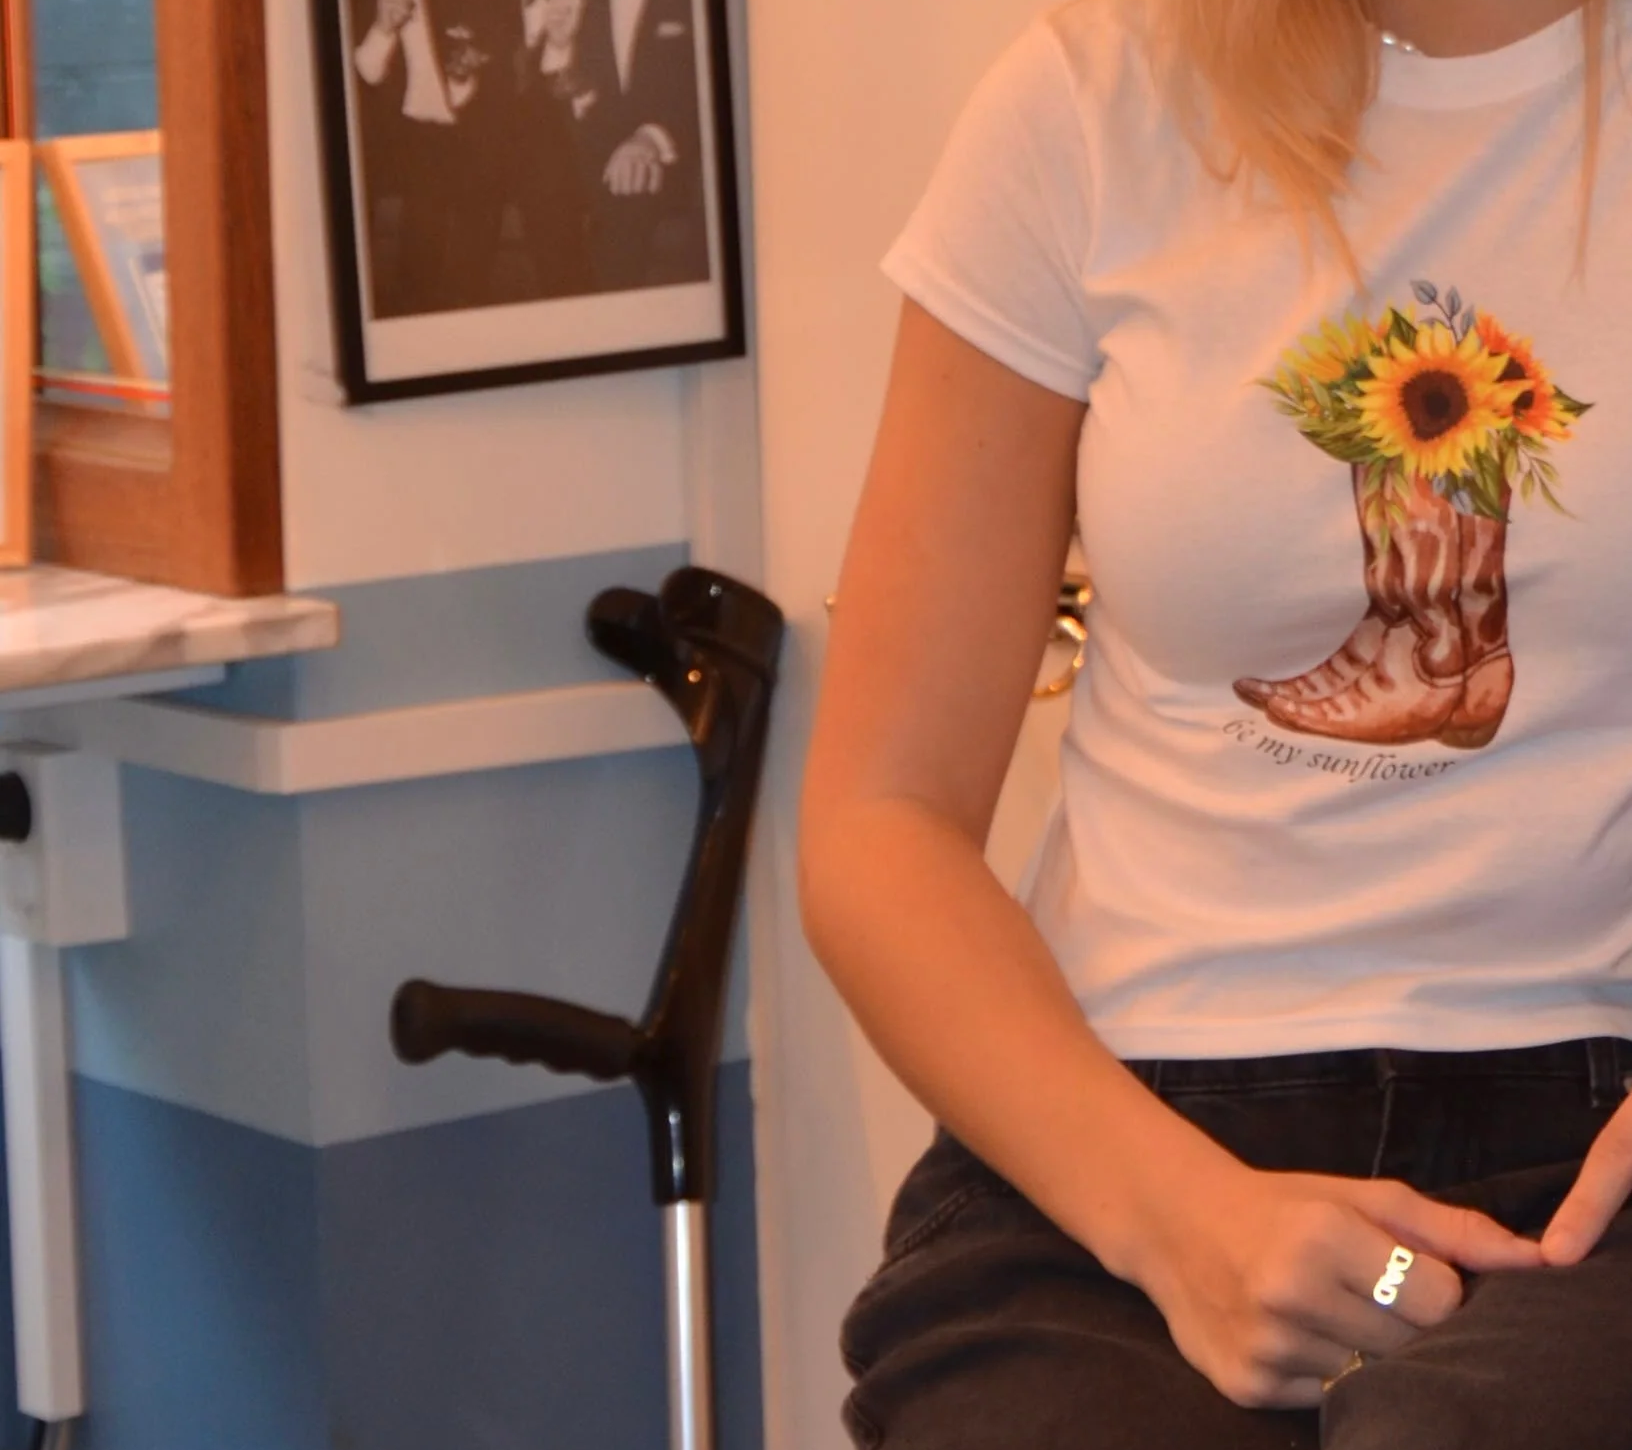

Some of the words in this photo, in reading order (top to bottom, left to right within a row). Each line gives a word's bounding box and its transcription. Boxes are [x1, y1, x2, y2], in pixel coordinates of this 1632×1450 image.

[1222, 719, 1256, 743] be
[1256, 733, 1302, 766] my
[1306, 752, 1457, 783] sunflower
